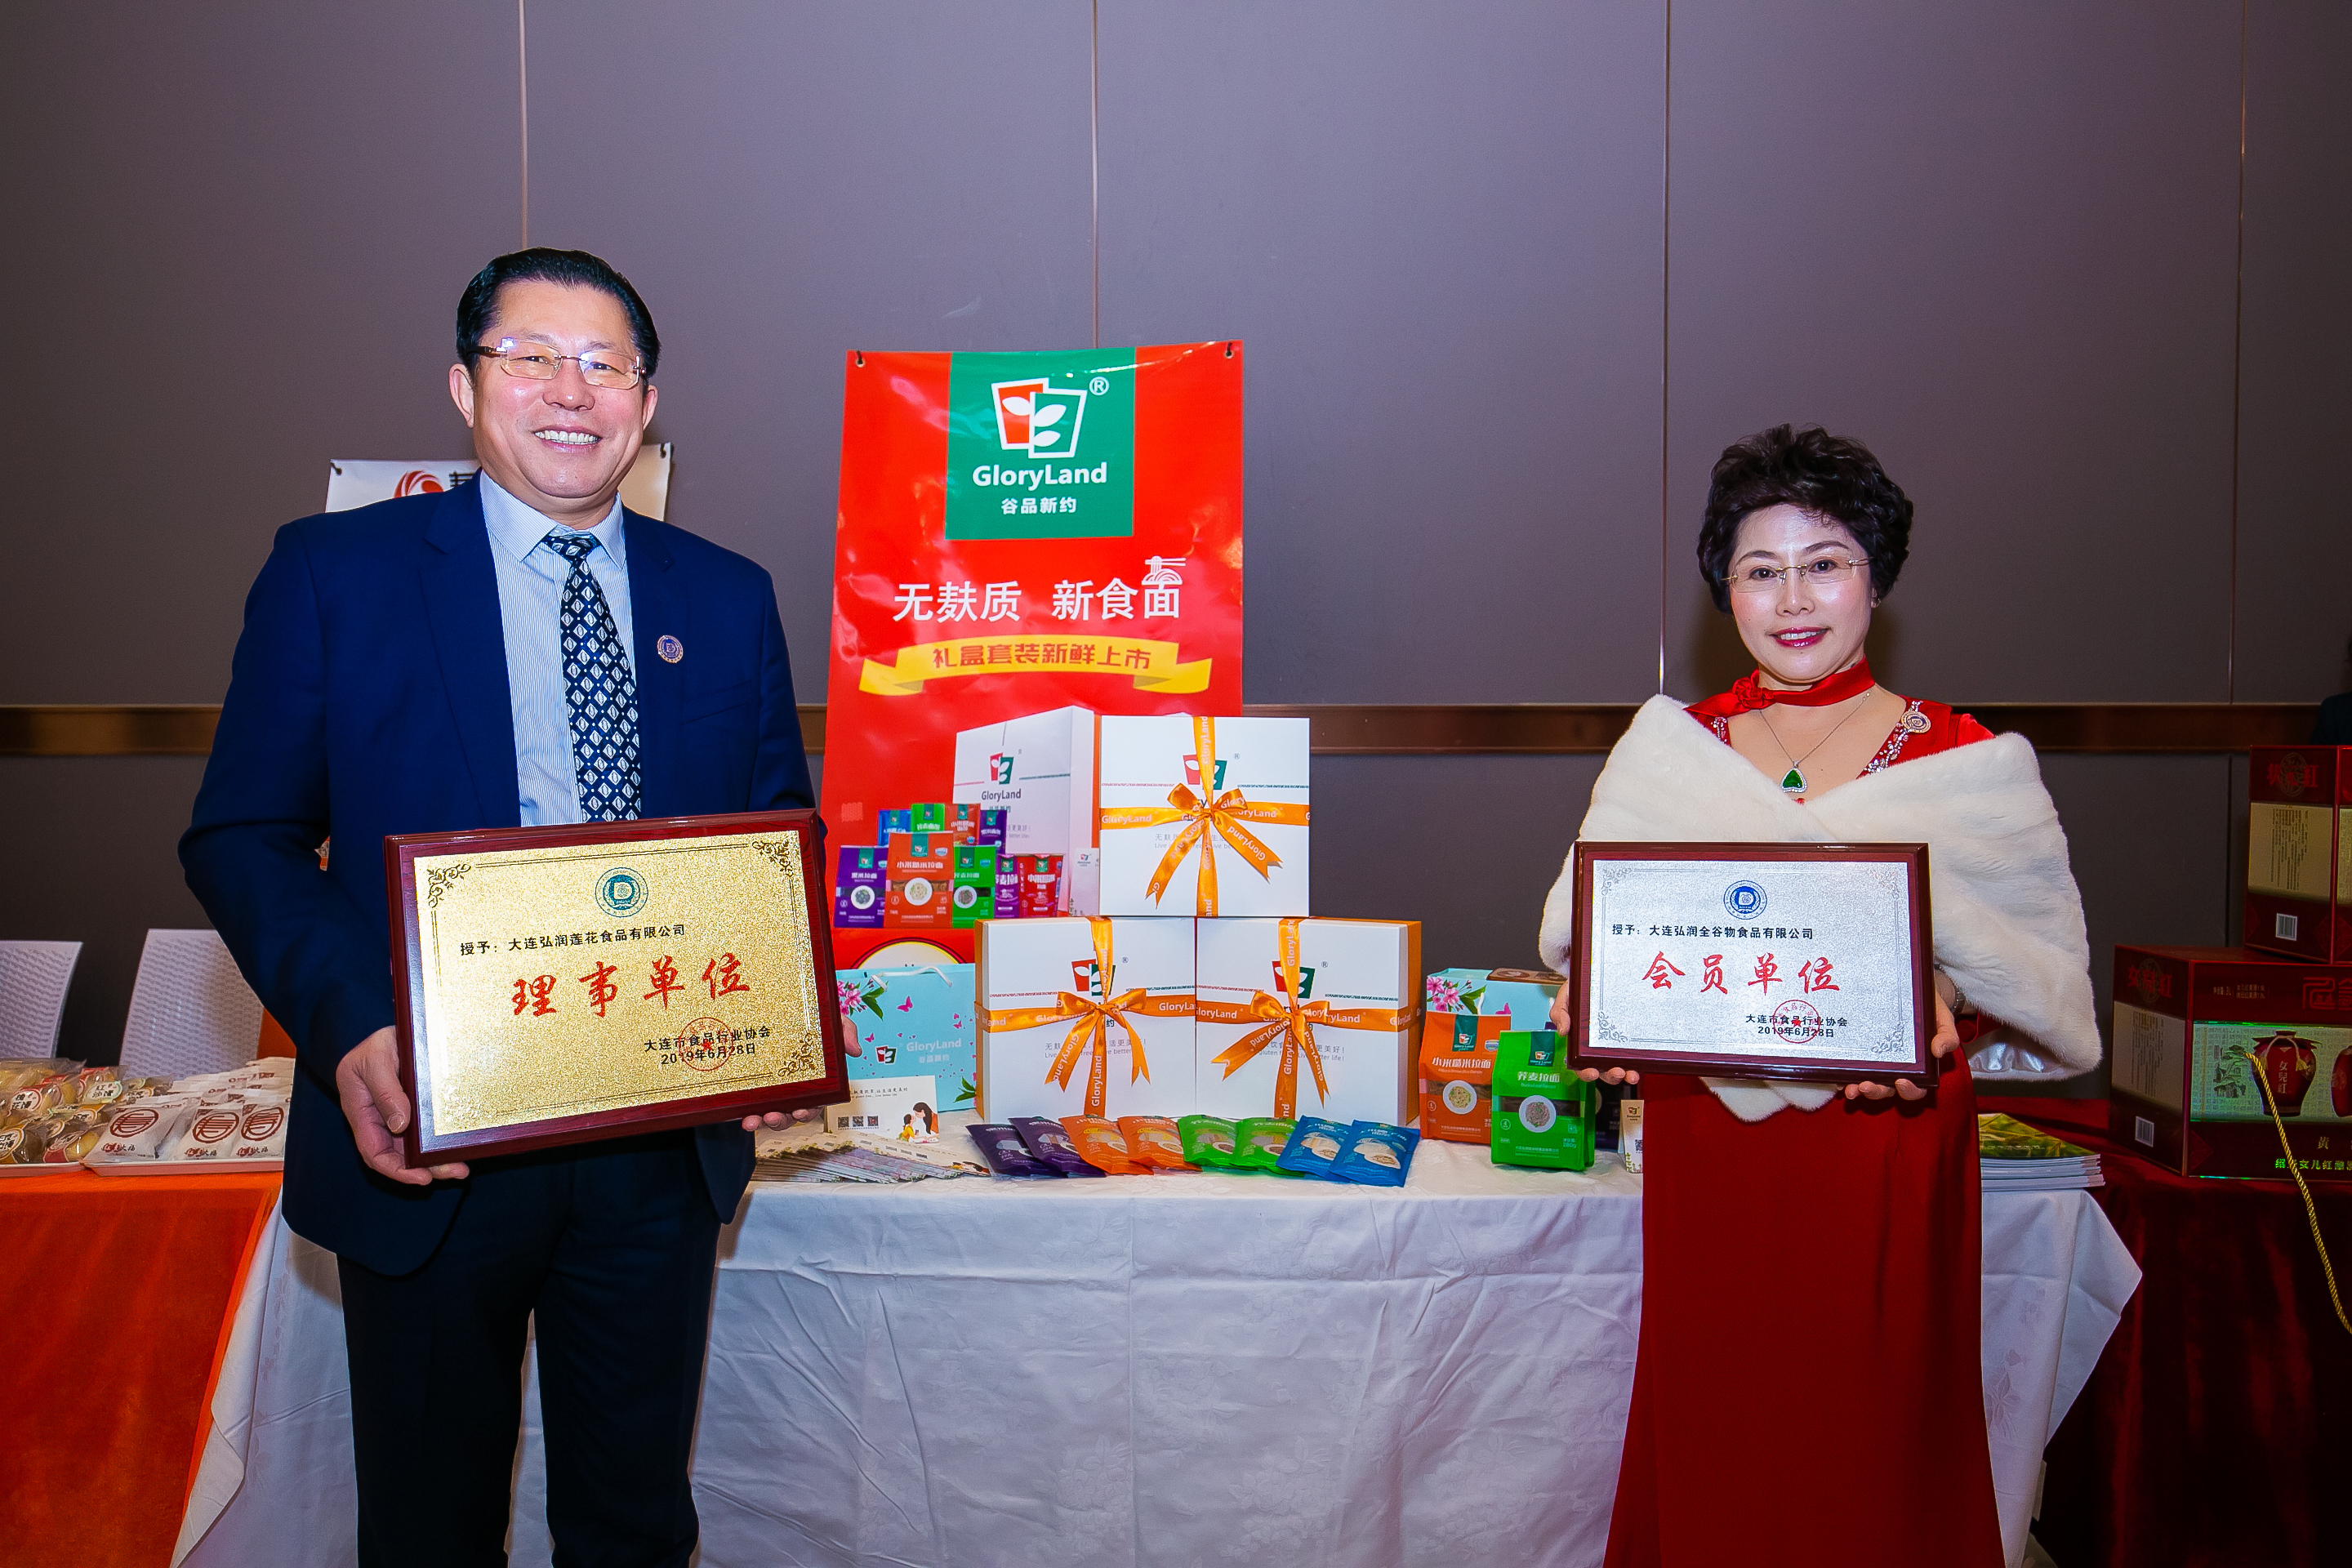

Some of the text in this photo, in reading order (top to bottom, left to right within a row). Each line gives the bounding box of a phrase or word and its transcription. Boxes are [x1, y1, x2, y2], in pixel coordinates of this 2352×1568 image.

[973, 462, 1107, 491] GloryLand
[1001, 497, 1077, 514] 谷品新约
[893, 577, 1182, 622] 无麸质 新食面
[933, 643, 1152, 670] 礼盒套装新鲜上市
[981, 788, 1022, 803] GloryLand
[1220, 796, 1245, 808] Glory
[1101, 814, 1152, 826] GloryLand
[1227, 826, 1266, 861] GloryLand
[510, 952, 750, 1018] 理事单位
[1642, 951, 1840, 996] 会员单位
[1159, 1001, 1196, 1012] GloryLa
[1745, 1013, 1848, 1027] 大连市食品行业协会
[1757, 1026, 1834, 1038] 2019年6月28日
[644, 1026, 771, 1052] 大连市食品行业协会
[906, 1037, 962, 1052] GloryLand
[661, 1043, 755, 1065] 2019年6月28日
[1284, 1030, 1295, 1075] GloryLan
[1091, 1055, 1102, 1107] GloryLand
